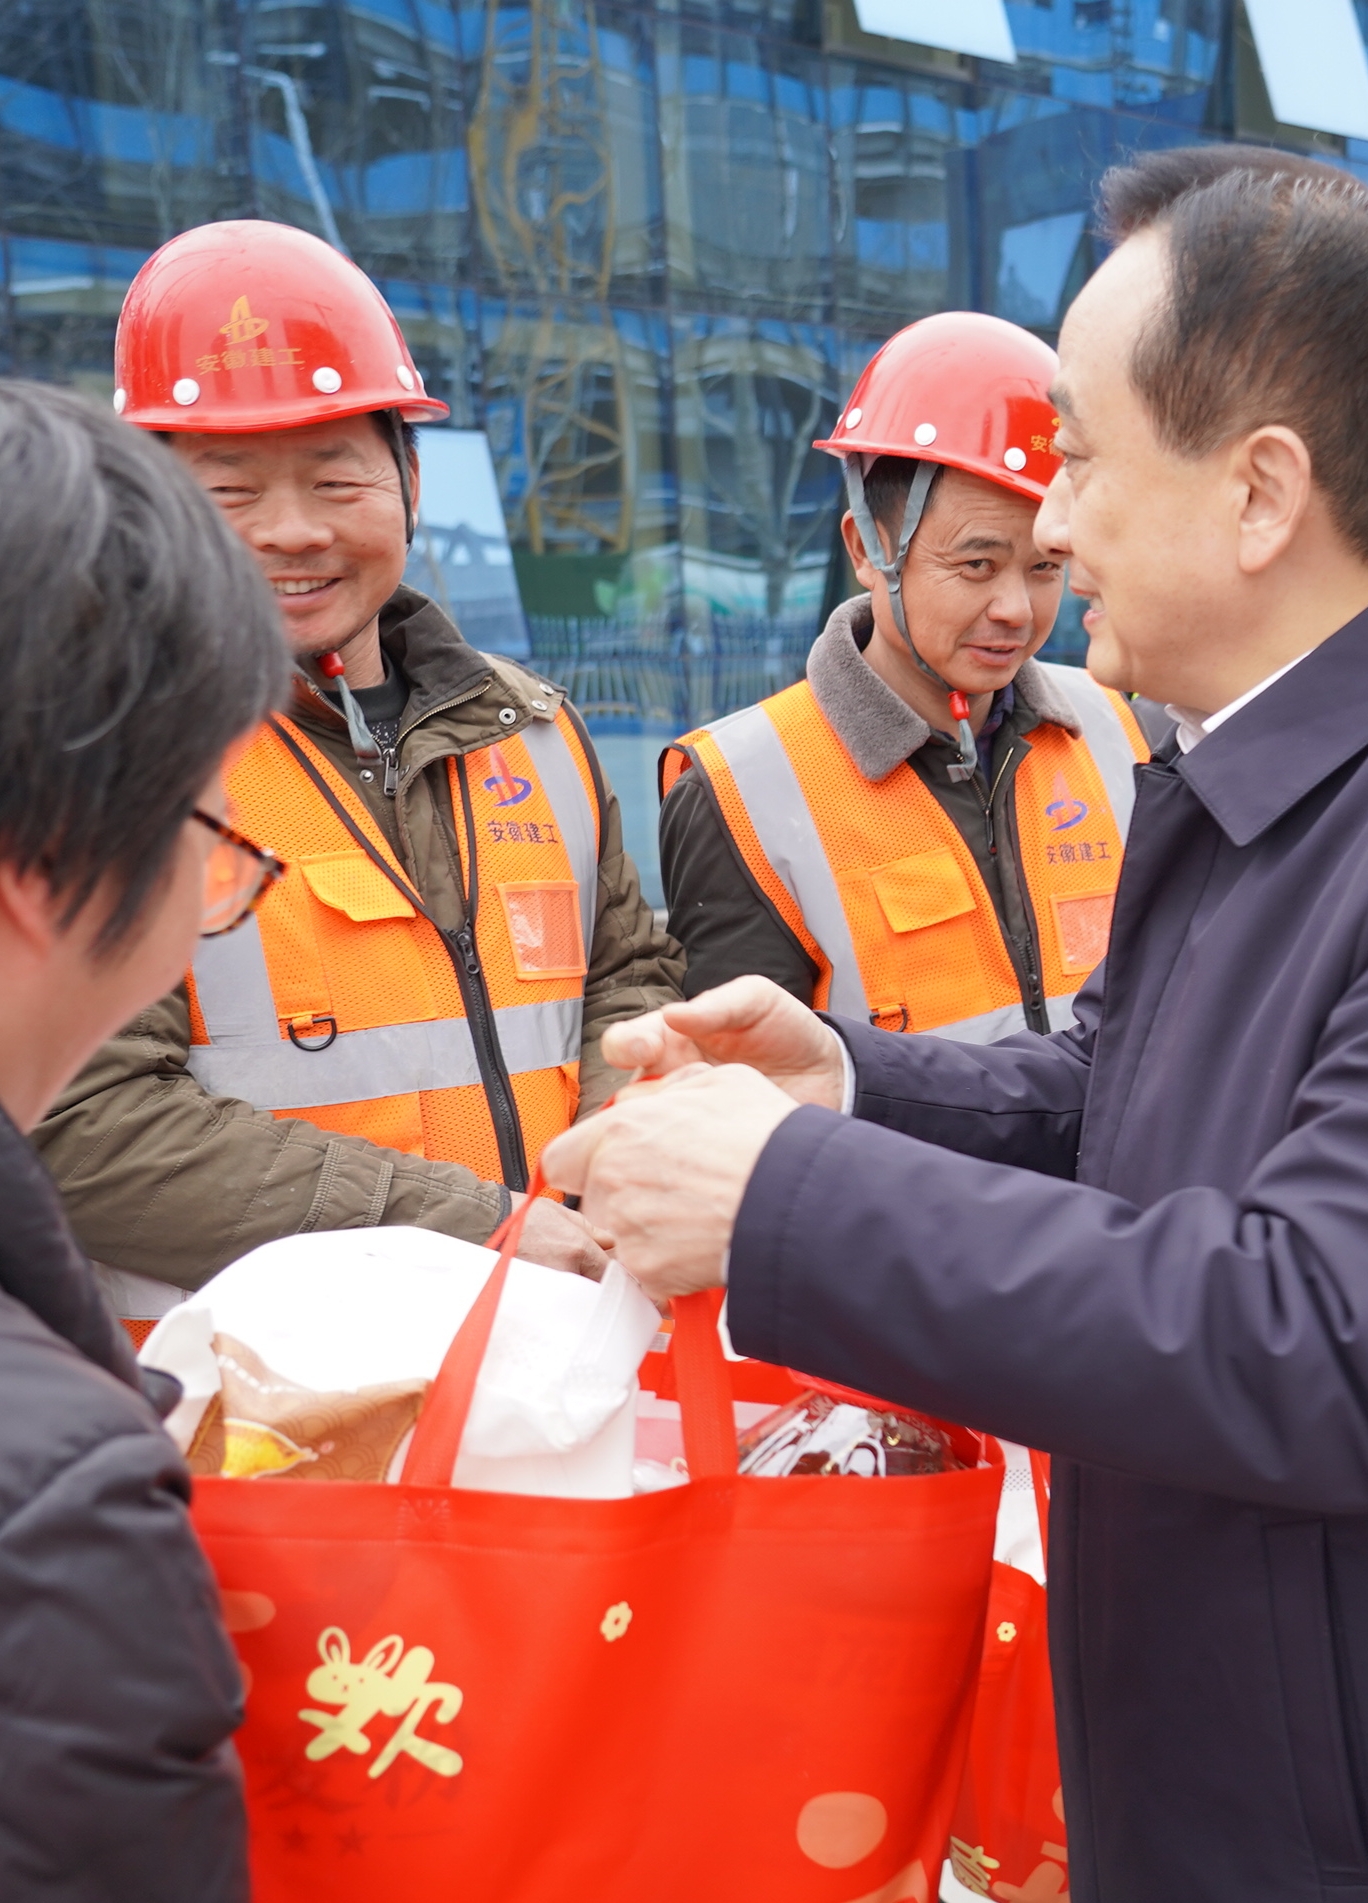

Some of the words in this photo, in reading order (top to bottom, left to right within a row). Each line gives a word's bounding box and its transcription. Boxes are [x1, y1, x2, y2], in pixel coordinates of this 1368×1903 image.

[195, 347, 306, 376] 安徽建工
[487, 819, 560, 844] 安徽建工
[1046, 841, 1112, 865] 安徽建工
